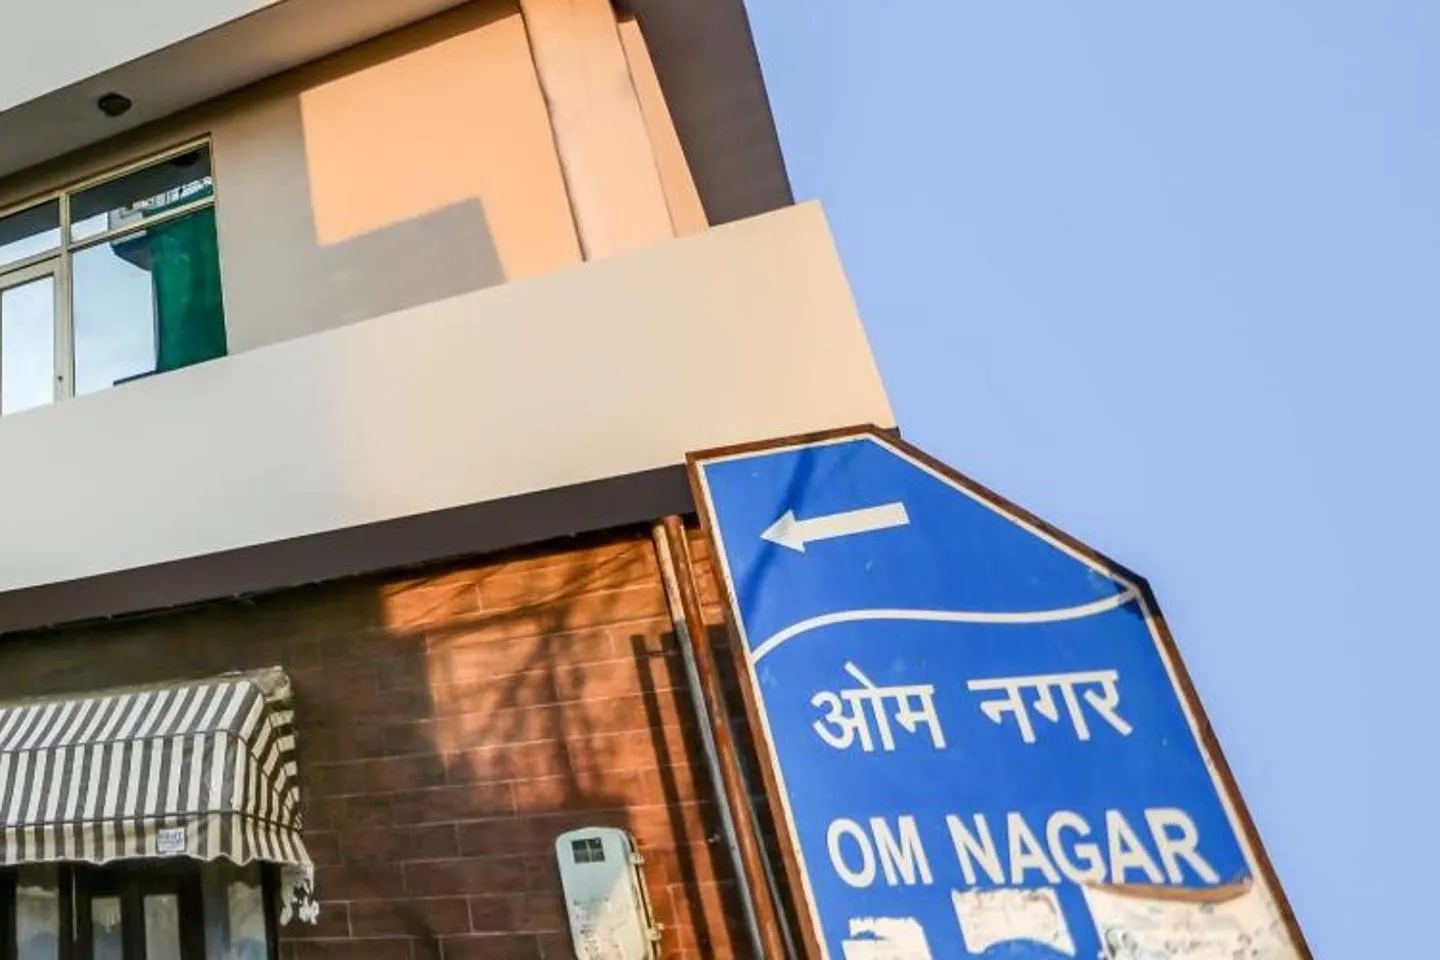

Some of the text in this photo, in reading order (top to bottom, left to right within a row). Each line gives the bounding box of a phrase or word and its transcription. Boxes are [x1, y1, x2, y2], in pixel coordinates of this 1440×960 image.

[811, 662, 1133, 752] ओम नगर
[826, 807, 1220, 888] OM NAGAR
